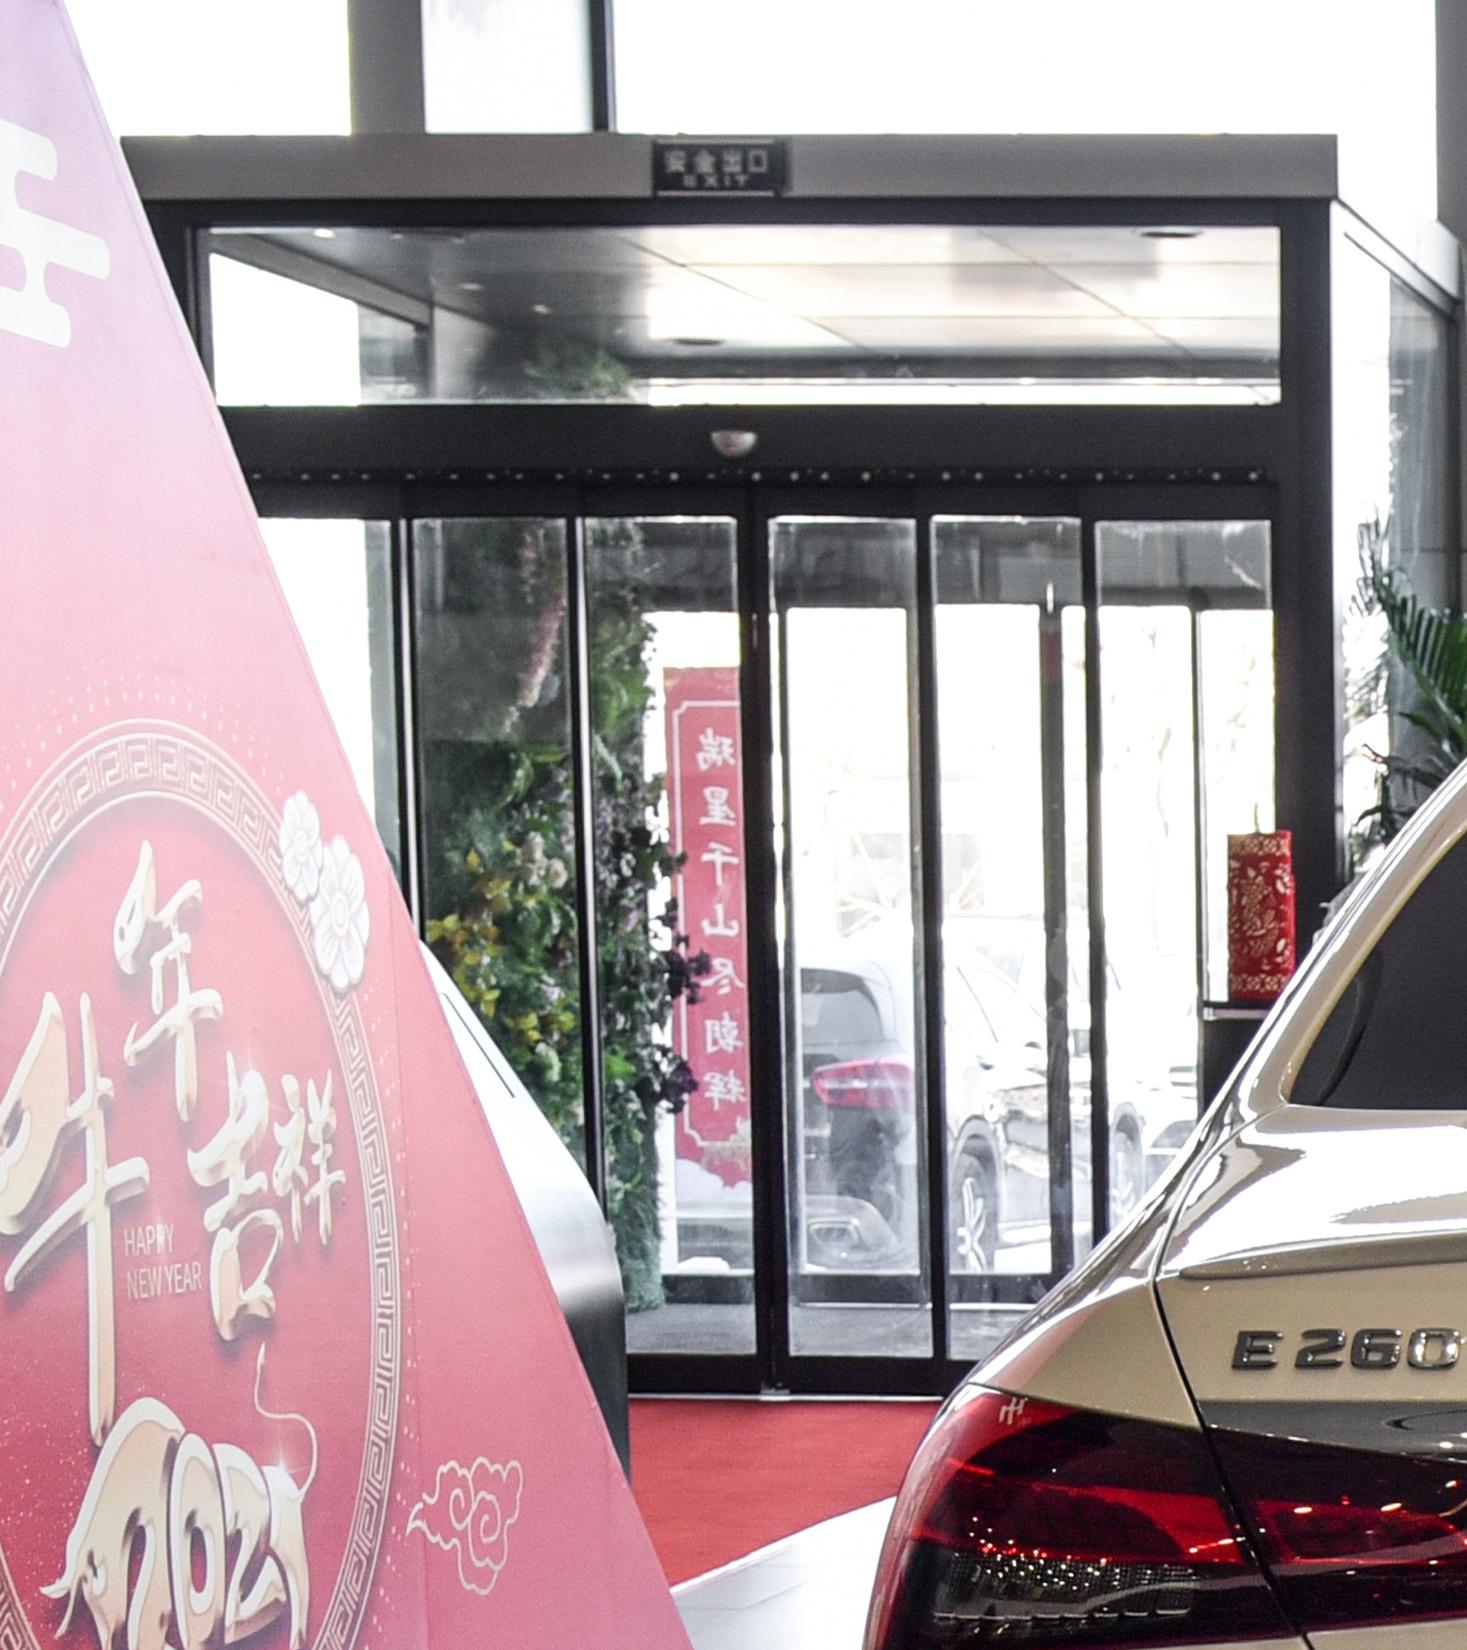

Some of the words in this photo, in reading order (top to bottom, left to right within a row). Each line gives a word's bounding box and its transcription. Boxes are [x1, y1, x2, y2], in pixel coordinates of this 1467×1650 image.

[124, 1223, 174, 1257] HAPPY
[126, 1266, 162, 1301] NEW
[164, 1261, 203, 1295] YEAR
[1231, 1330, 1284, 1369] E
[1294, 1328, 1464, 1370] 260
